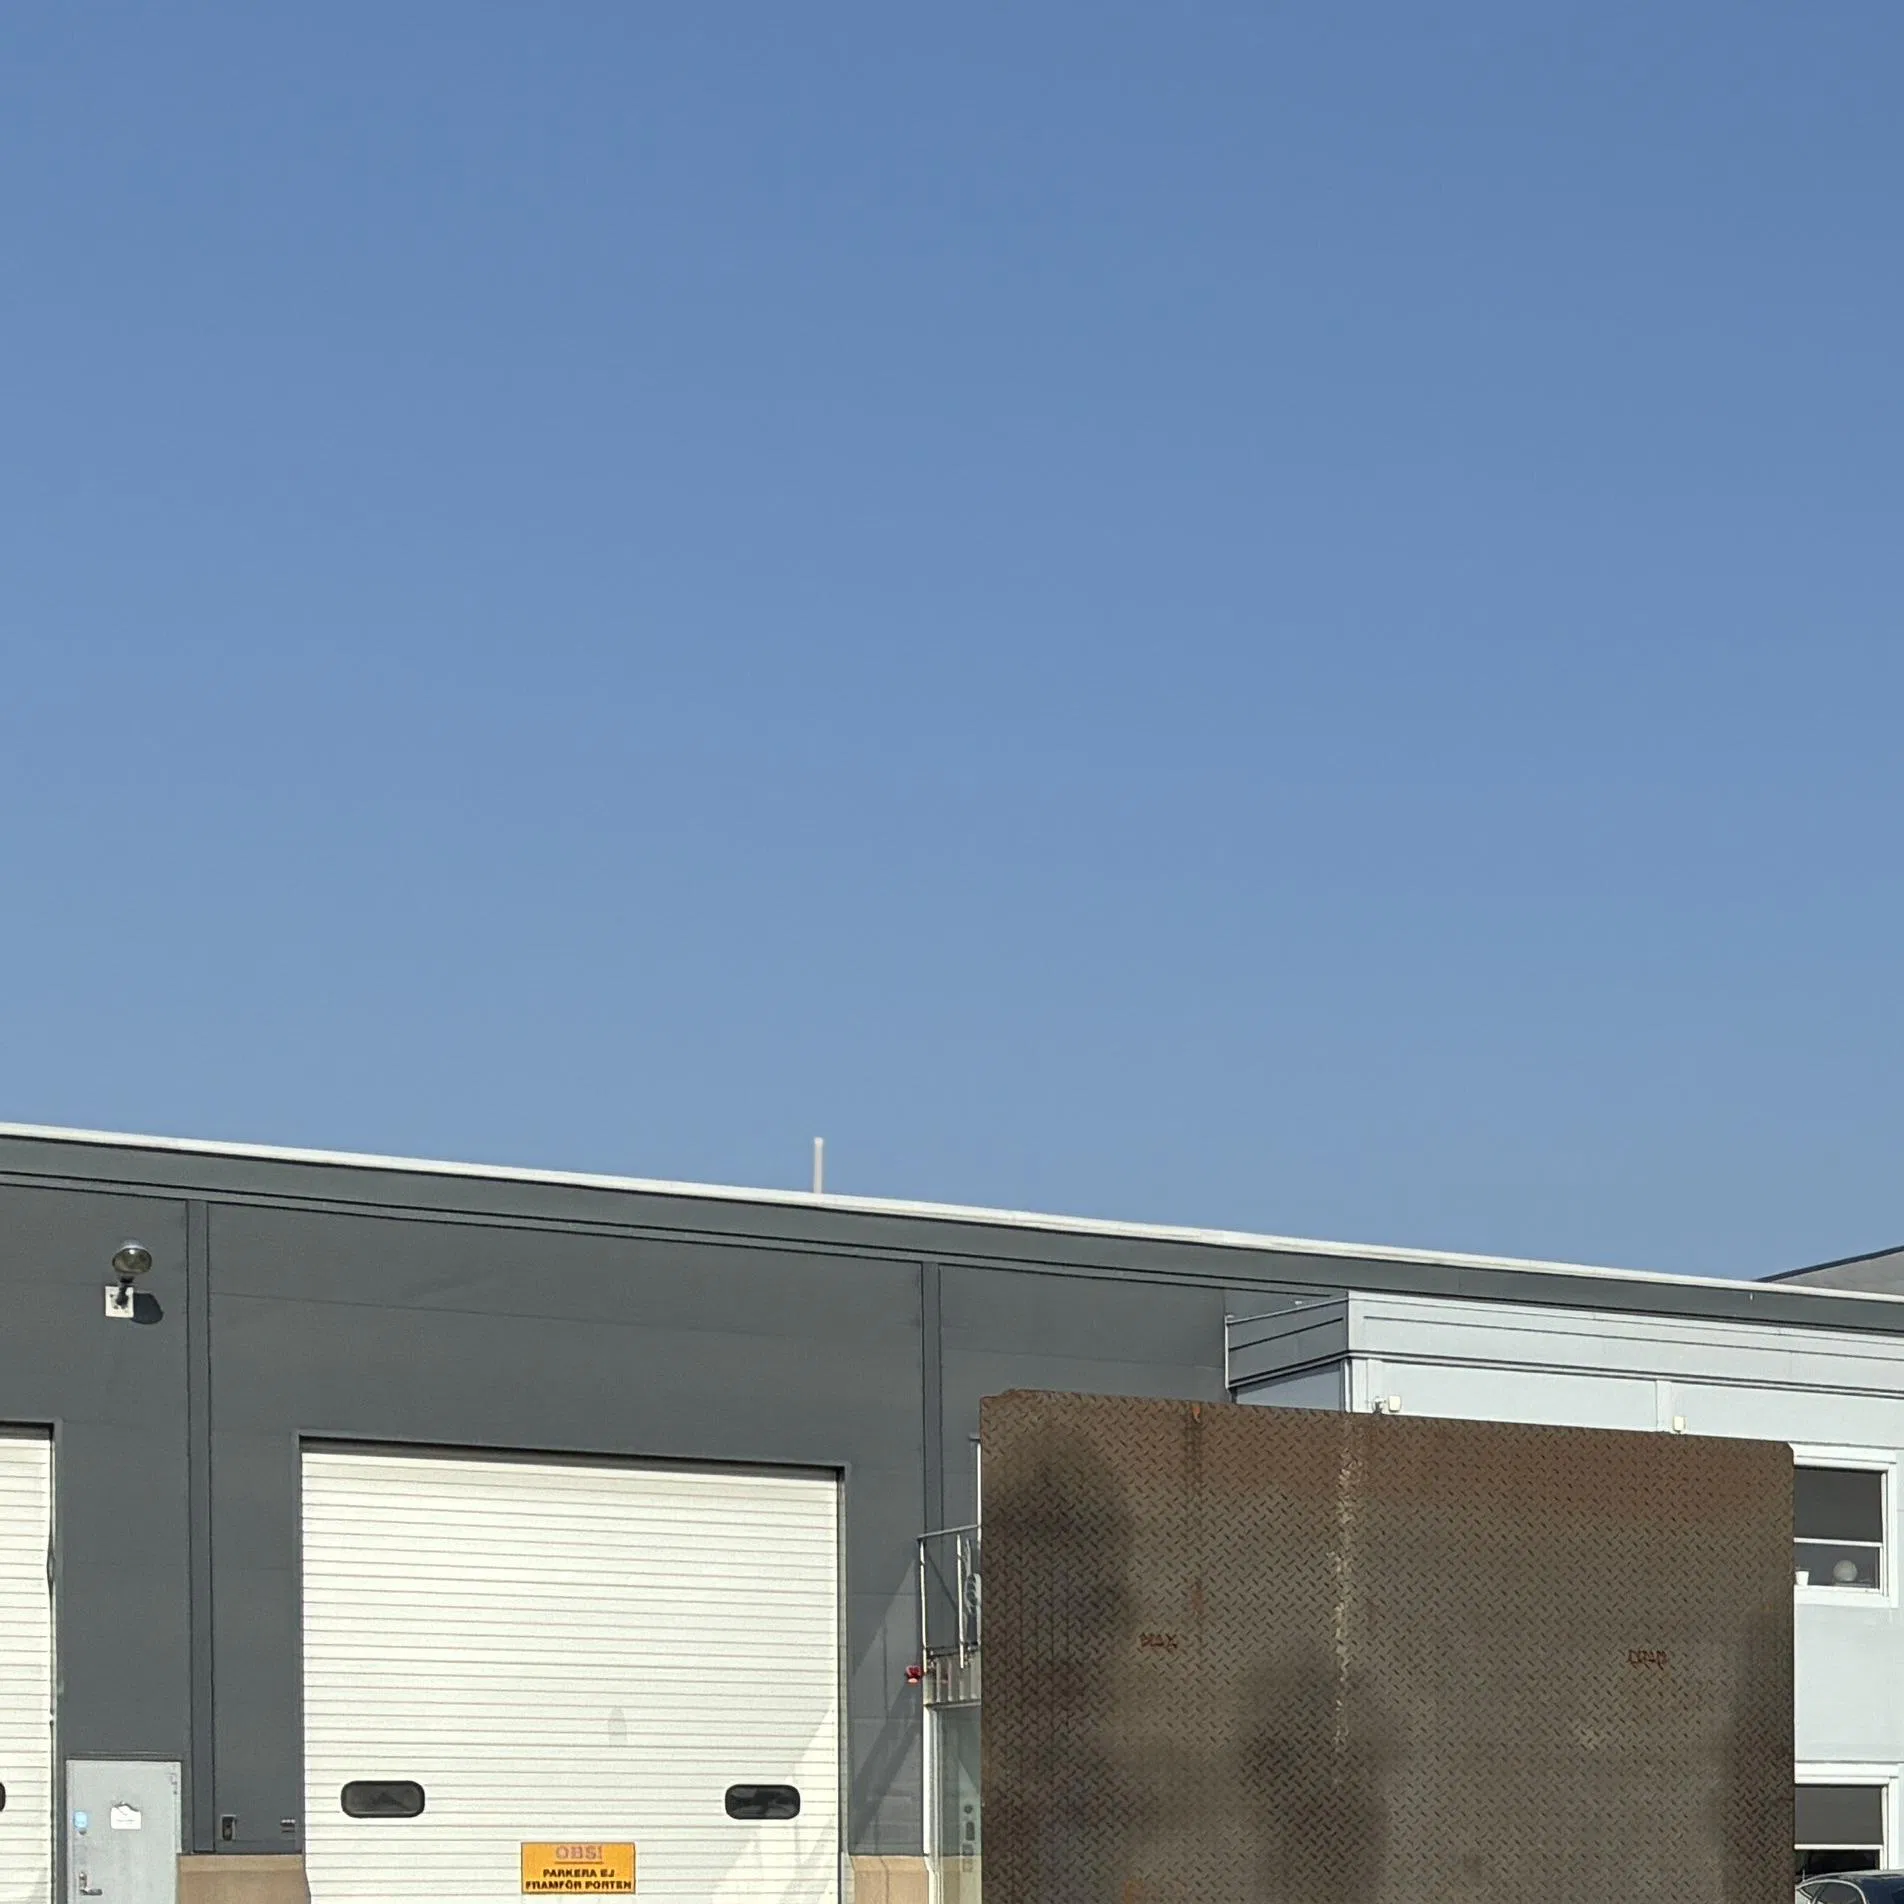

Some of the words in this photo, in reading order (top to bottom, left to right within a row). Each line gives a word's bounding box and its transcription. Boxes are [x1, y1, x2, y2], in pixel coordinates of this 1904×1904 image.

[555, 1845, 603, 1860] OBS!
[543, 1868, 598, 1878] PARKERA
[600, 1868, 615, 1878] EJ
[525, 1879, 582, 1890] FRAMFÖR
[585, 1880, 632, 1890] PORTEN
